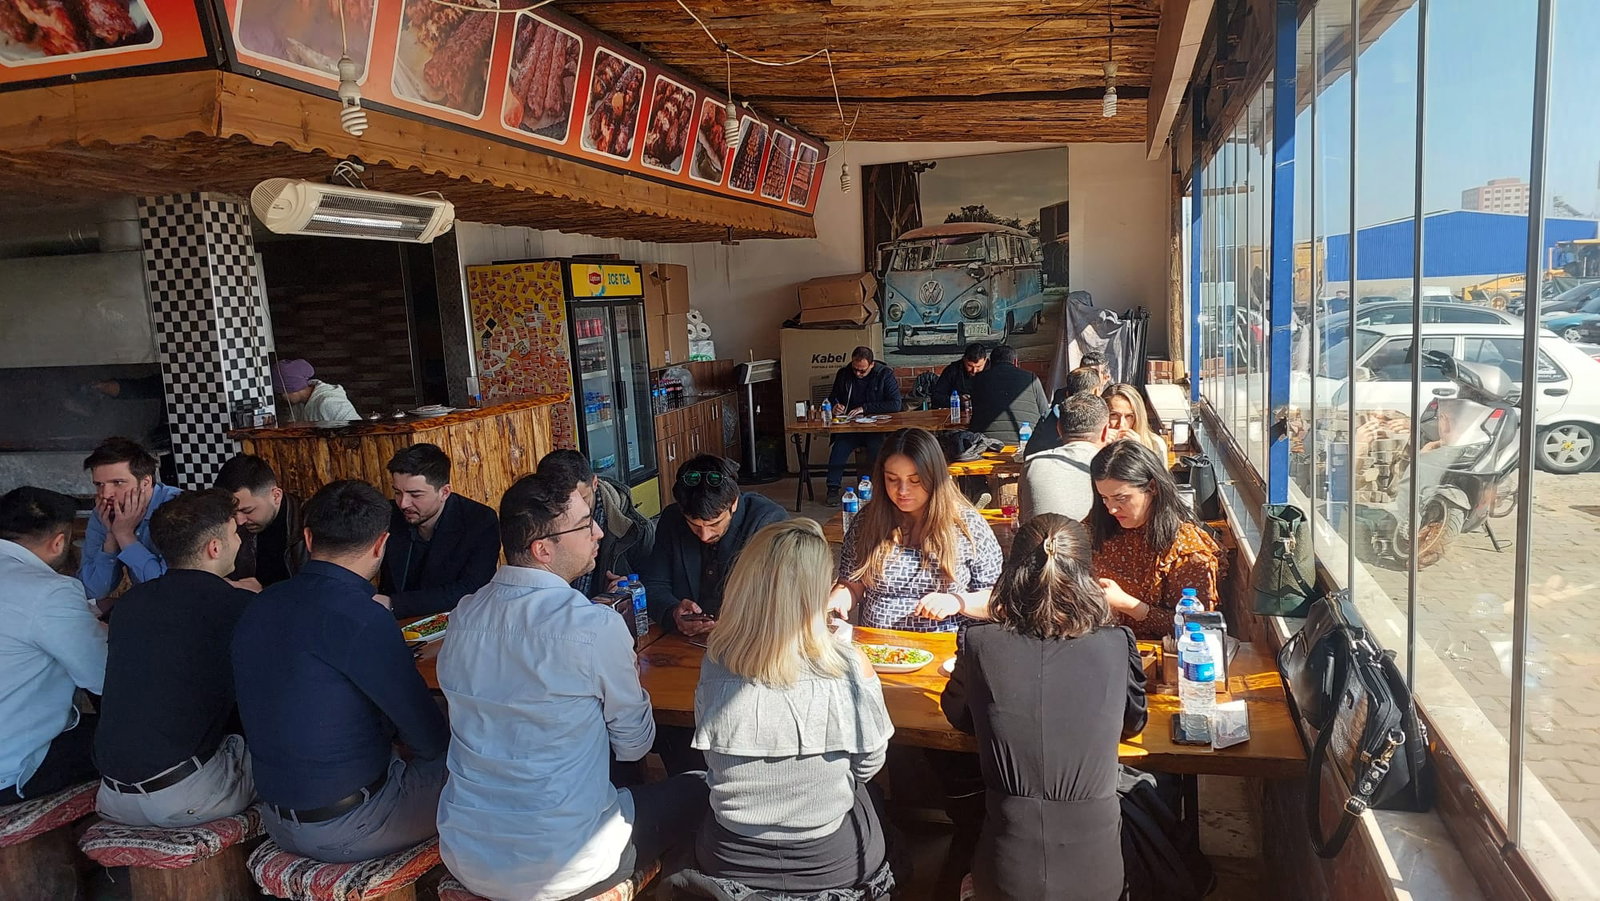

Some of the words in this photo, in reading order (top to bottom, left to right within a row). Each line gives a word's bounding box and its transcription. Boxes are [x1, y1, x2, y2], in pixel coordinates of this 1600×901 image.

[608, 273, 619, 285] ICE
[619, 273, 631, 285] TEA
[811, 352, 847, 364] Kabel
